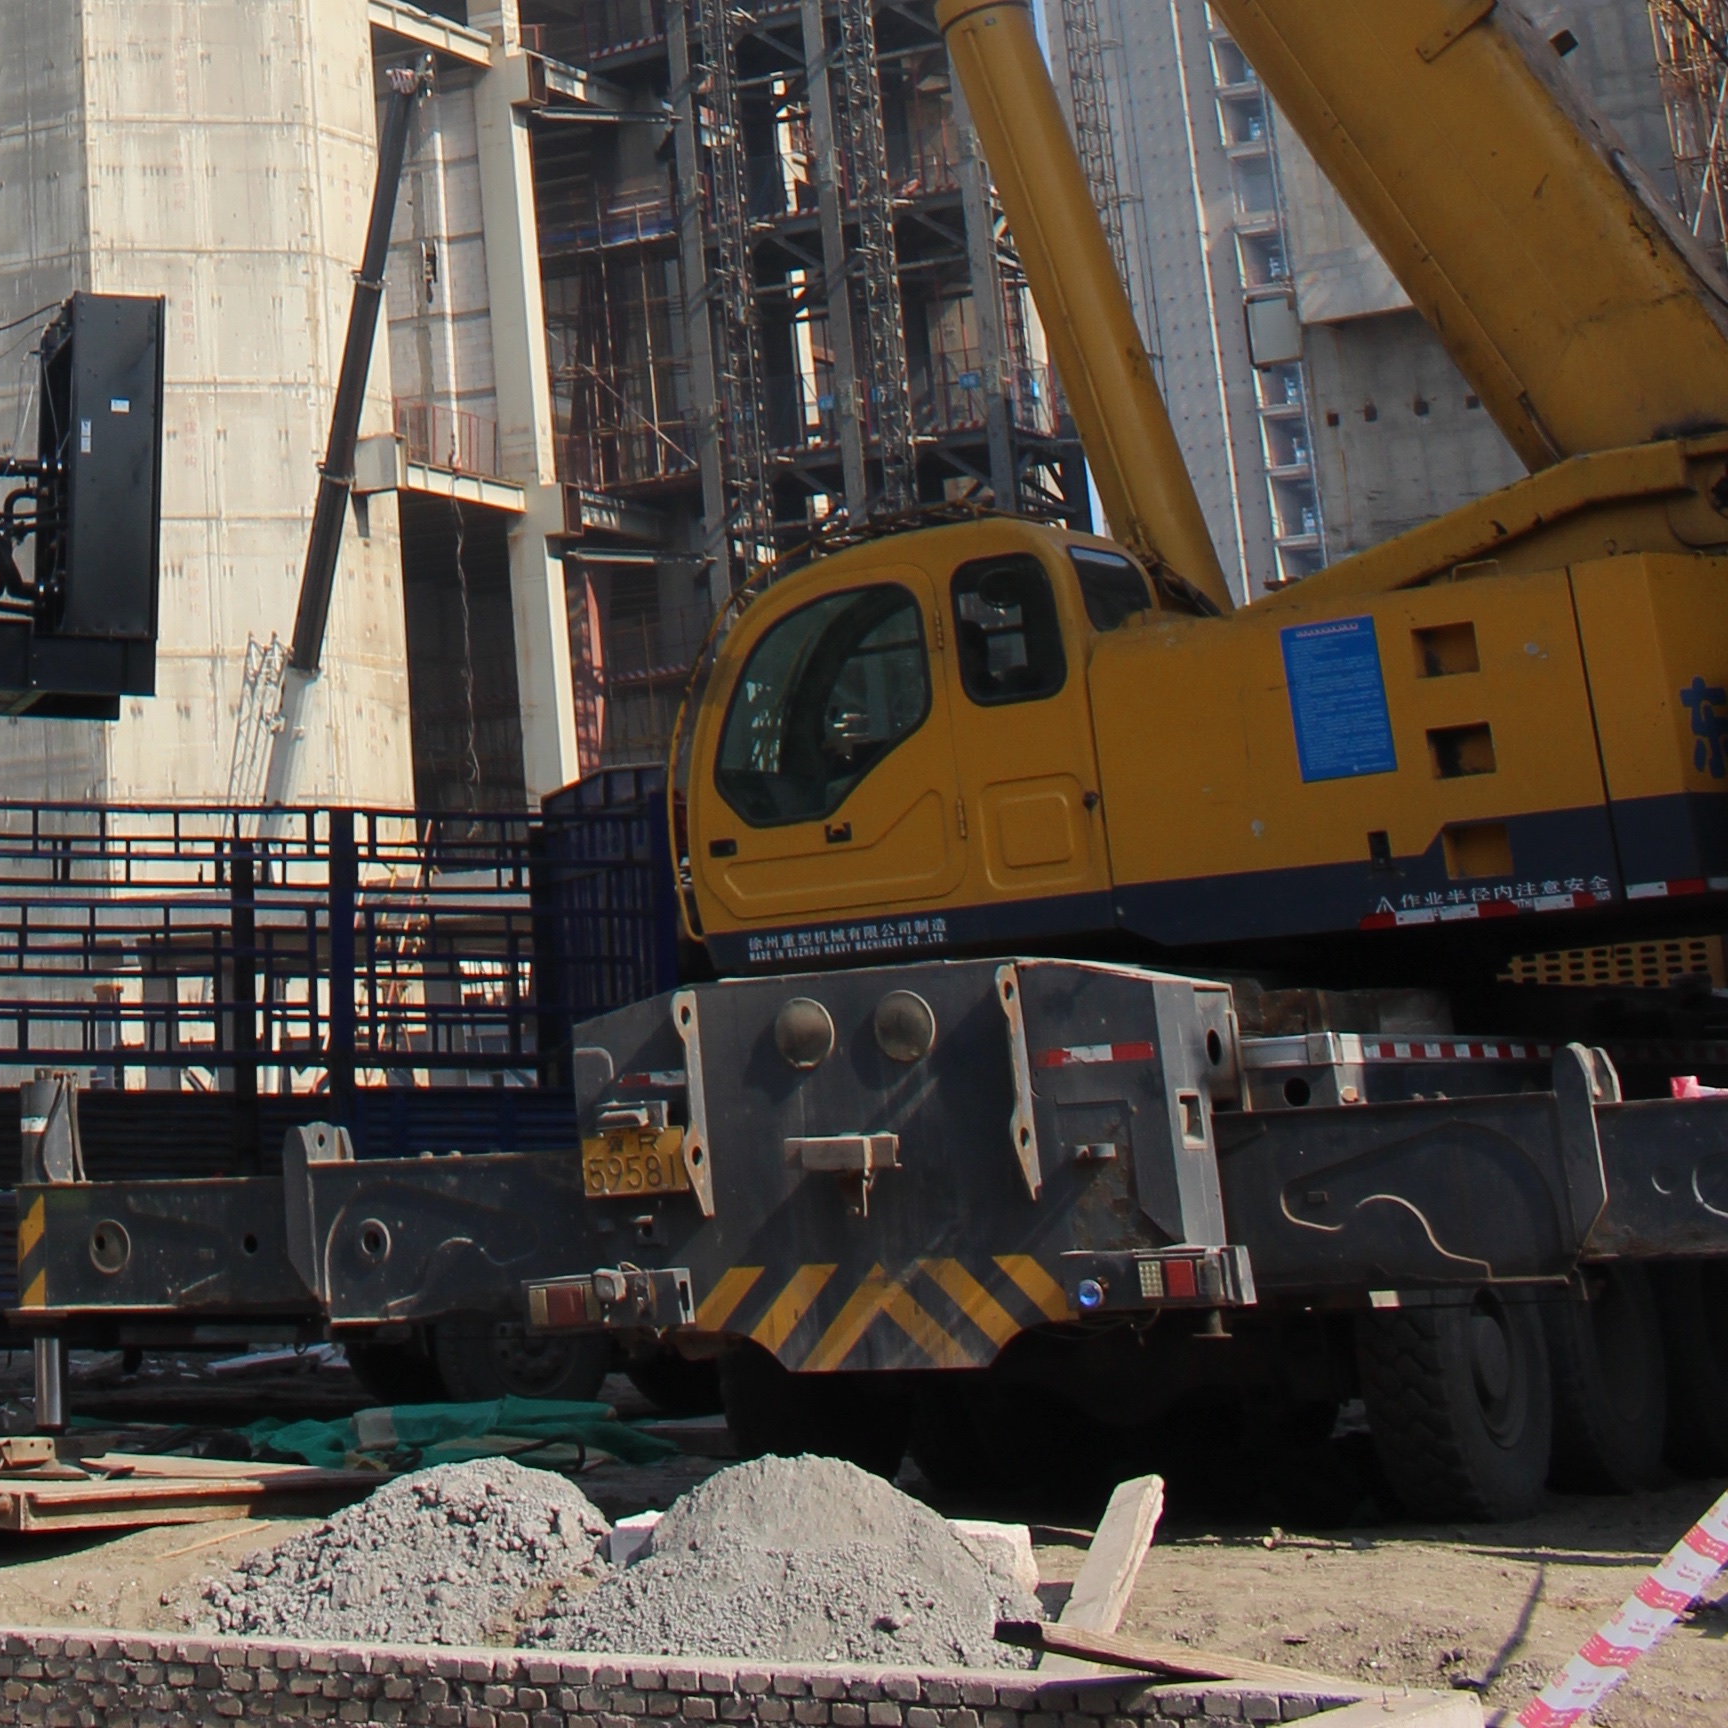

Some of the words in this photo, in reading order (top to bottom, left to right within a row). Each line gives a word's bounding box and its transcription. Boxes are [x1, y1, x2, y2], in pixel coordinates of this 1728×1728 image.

[1401, 875, 1608, 908] 作业半径内注意安全
[749, 917, 947, 951] 徐州重型机械有限公司制造
[749, 950, 771, 962] MADE
[775, 949, 784, 960] IN
[787, 946, 821, 959] XUZHOU
[824, 942, 851, 955] HEAVY
[855, 937, 903, 951] MACHINERY
[588, 1152, 677, 1191] 59581
